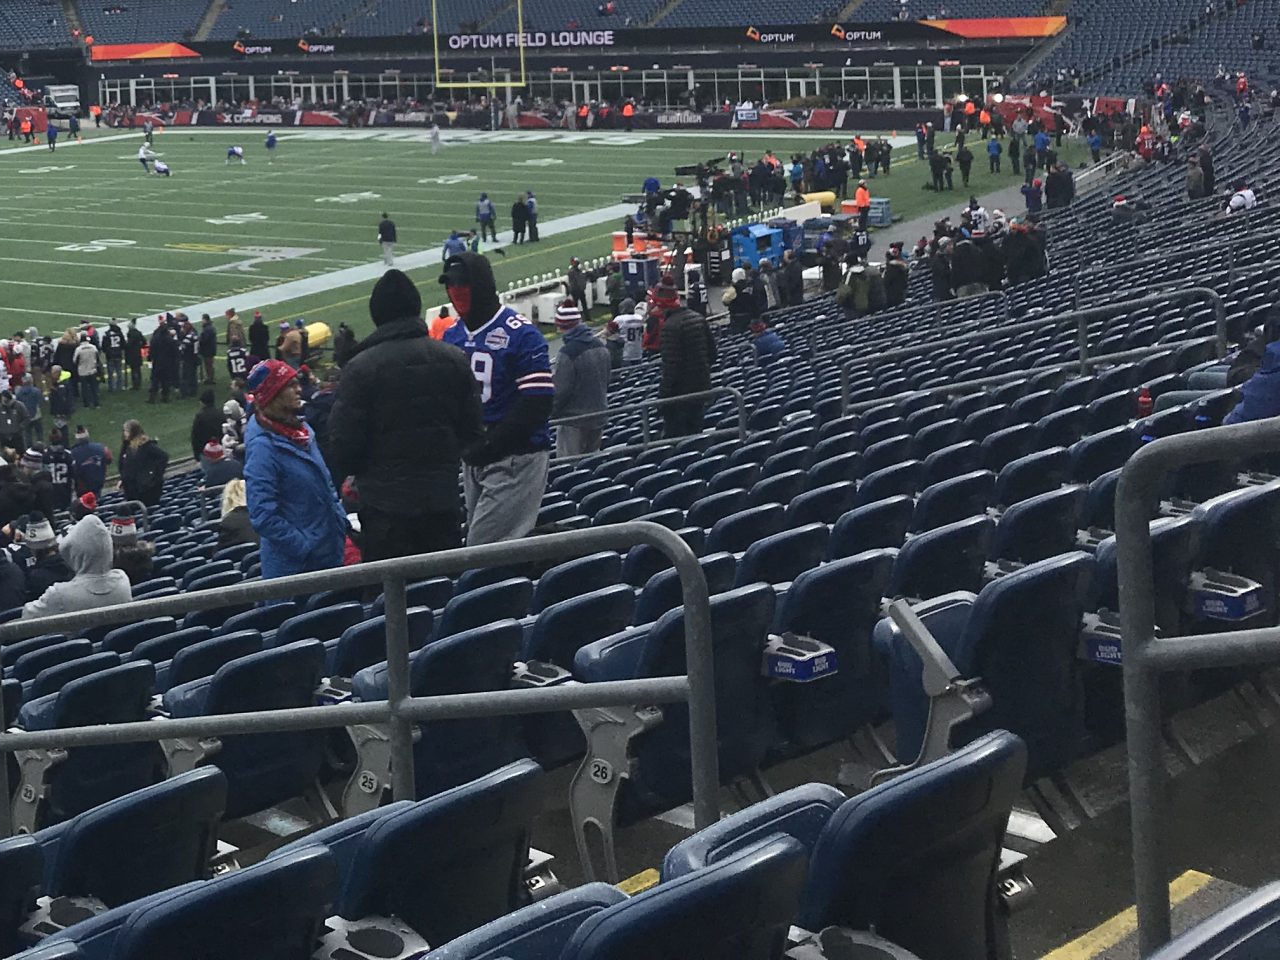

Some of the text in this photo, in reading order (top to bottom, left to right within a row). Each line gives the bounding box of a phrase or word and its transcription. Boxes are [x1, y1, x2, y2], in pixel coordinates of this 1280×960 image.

[449, 31, 614, 49] OPTUM FIELD LOUNGE
[760, 33, 794, 42] OPTUM
[846, 31, 881, 41] OPTUM
[244, 46, 272, 54] OPTUM
[54, 238, 138, 253] 50
[230, 357, 247, 373] 12
[48, 462, 68, 484] 12
[592, 763, 609, 780] 26
[361, 775, 375, 790] 25
